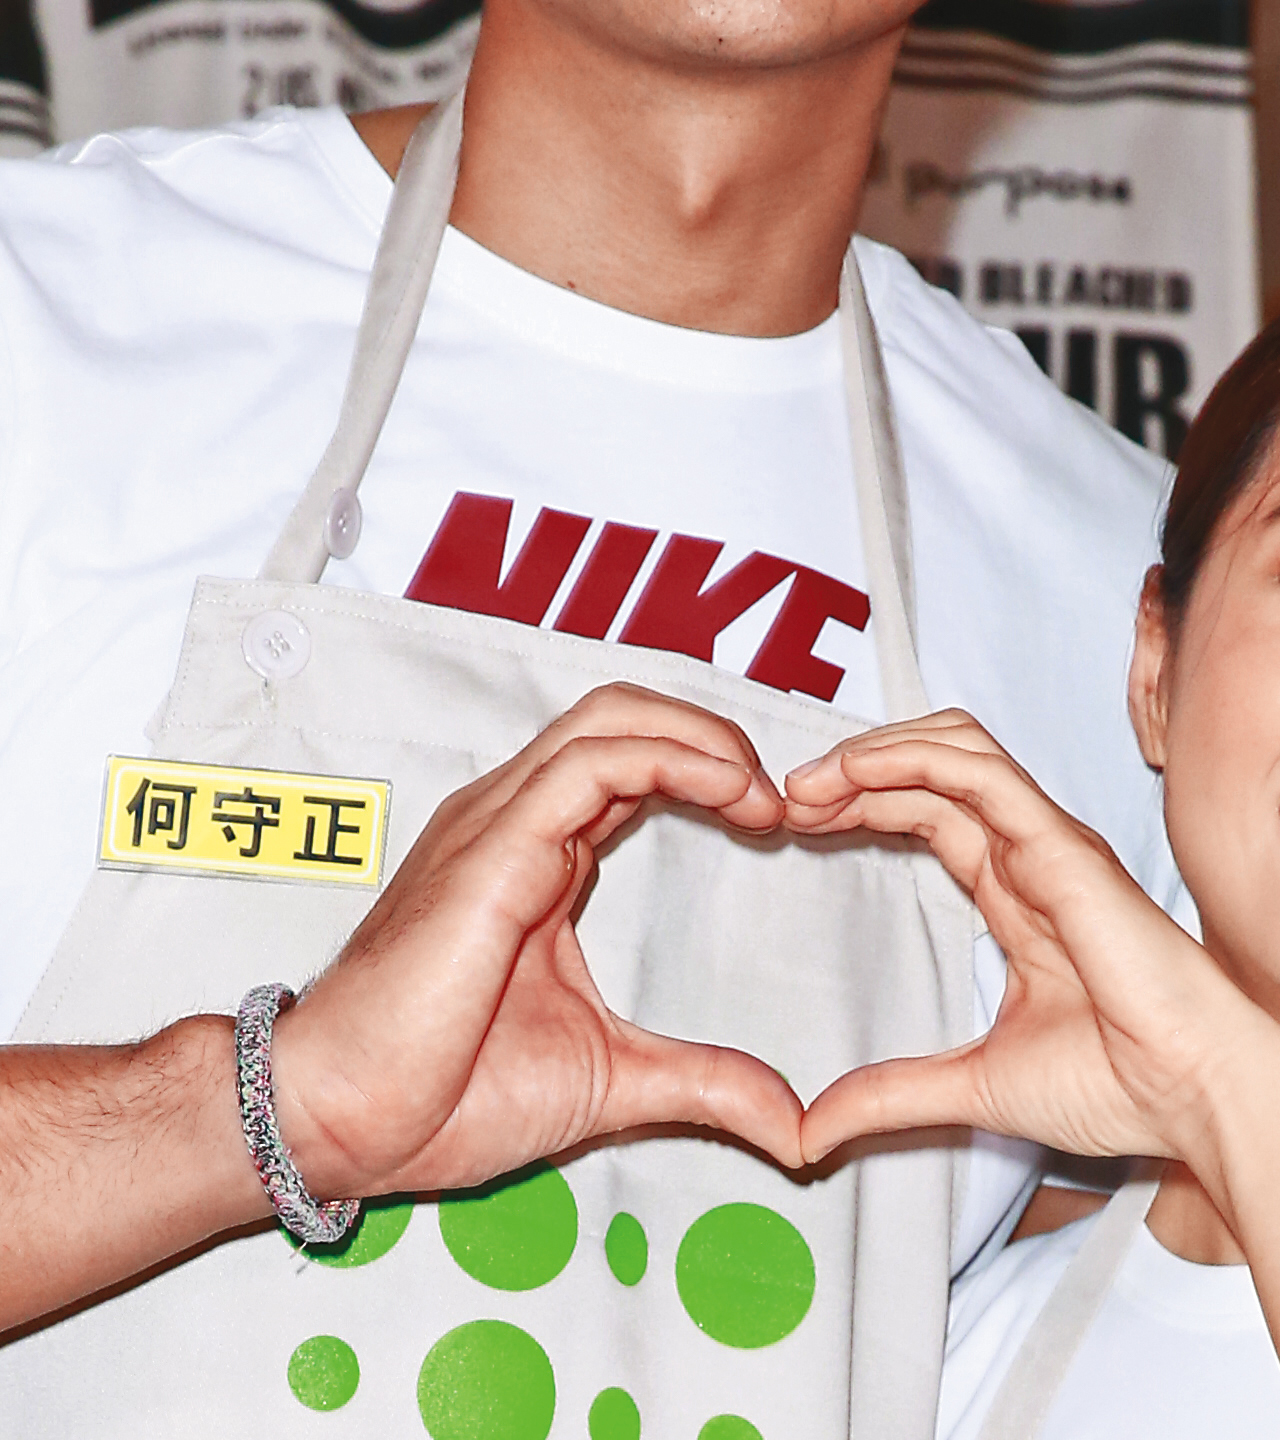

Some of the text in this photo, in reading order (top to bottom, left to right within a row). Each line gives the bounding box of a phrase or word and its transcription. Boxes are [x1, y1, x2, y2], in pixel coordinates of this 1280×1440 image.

[979, 261, 1194, 315] BLEACHED
[126, 776, 367, 867] 何守正
